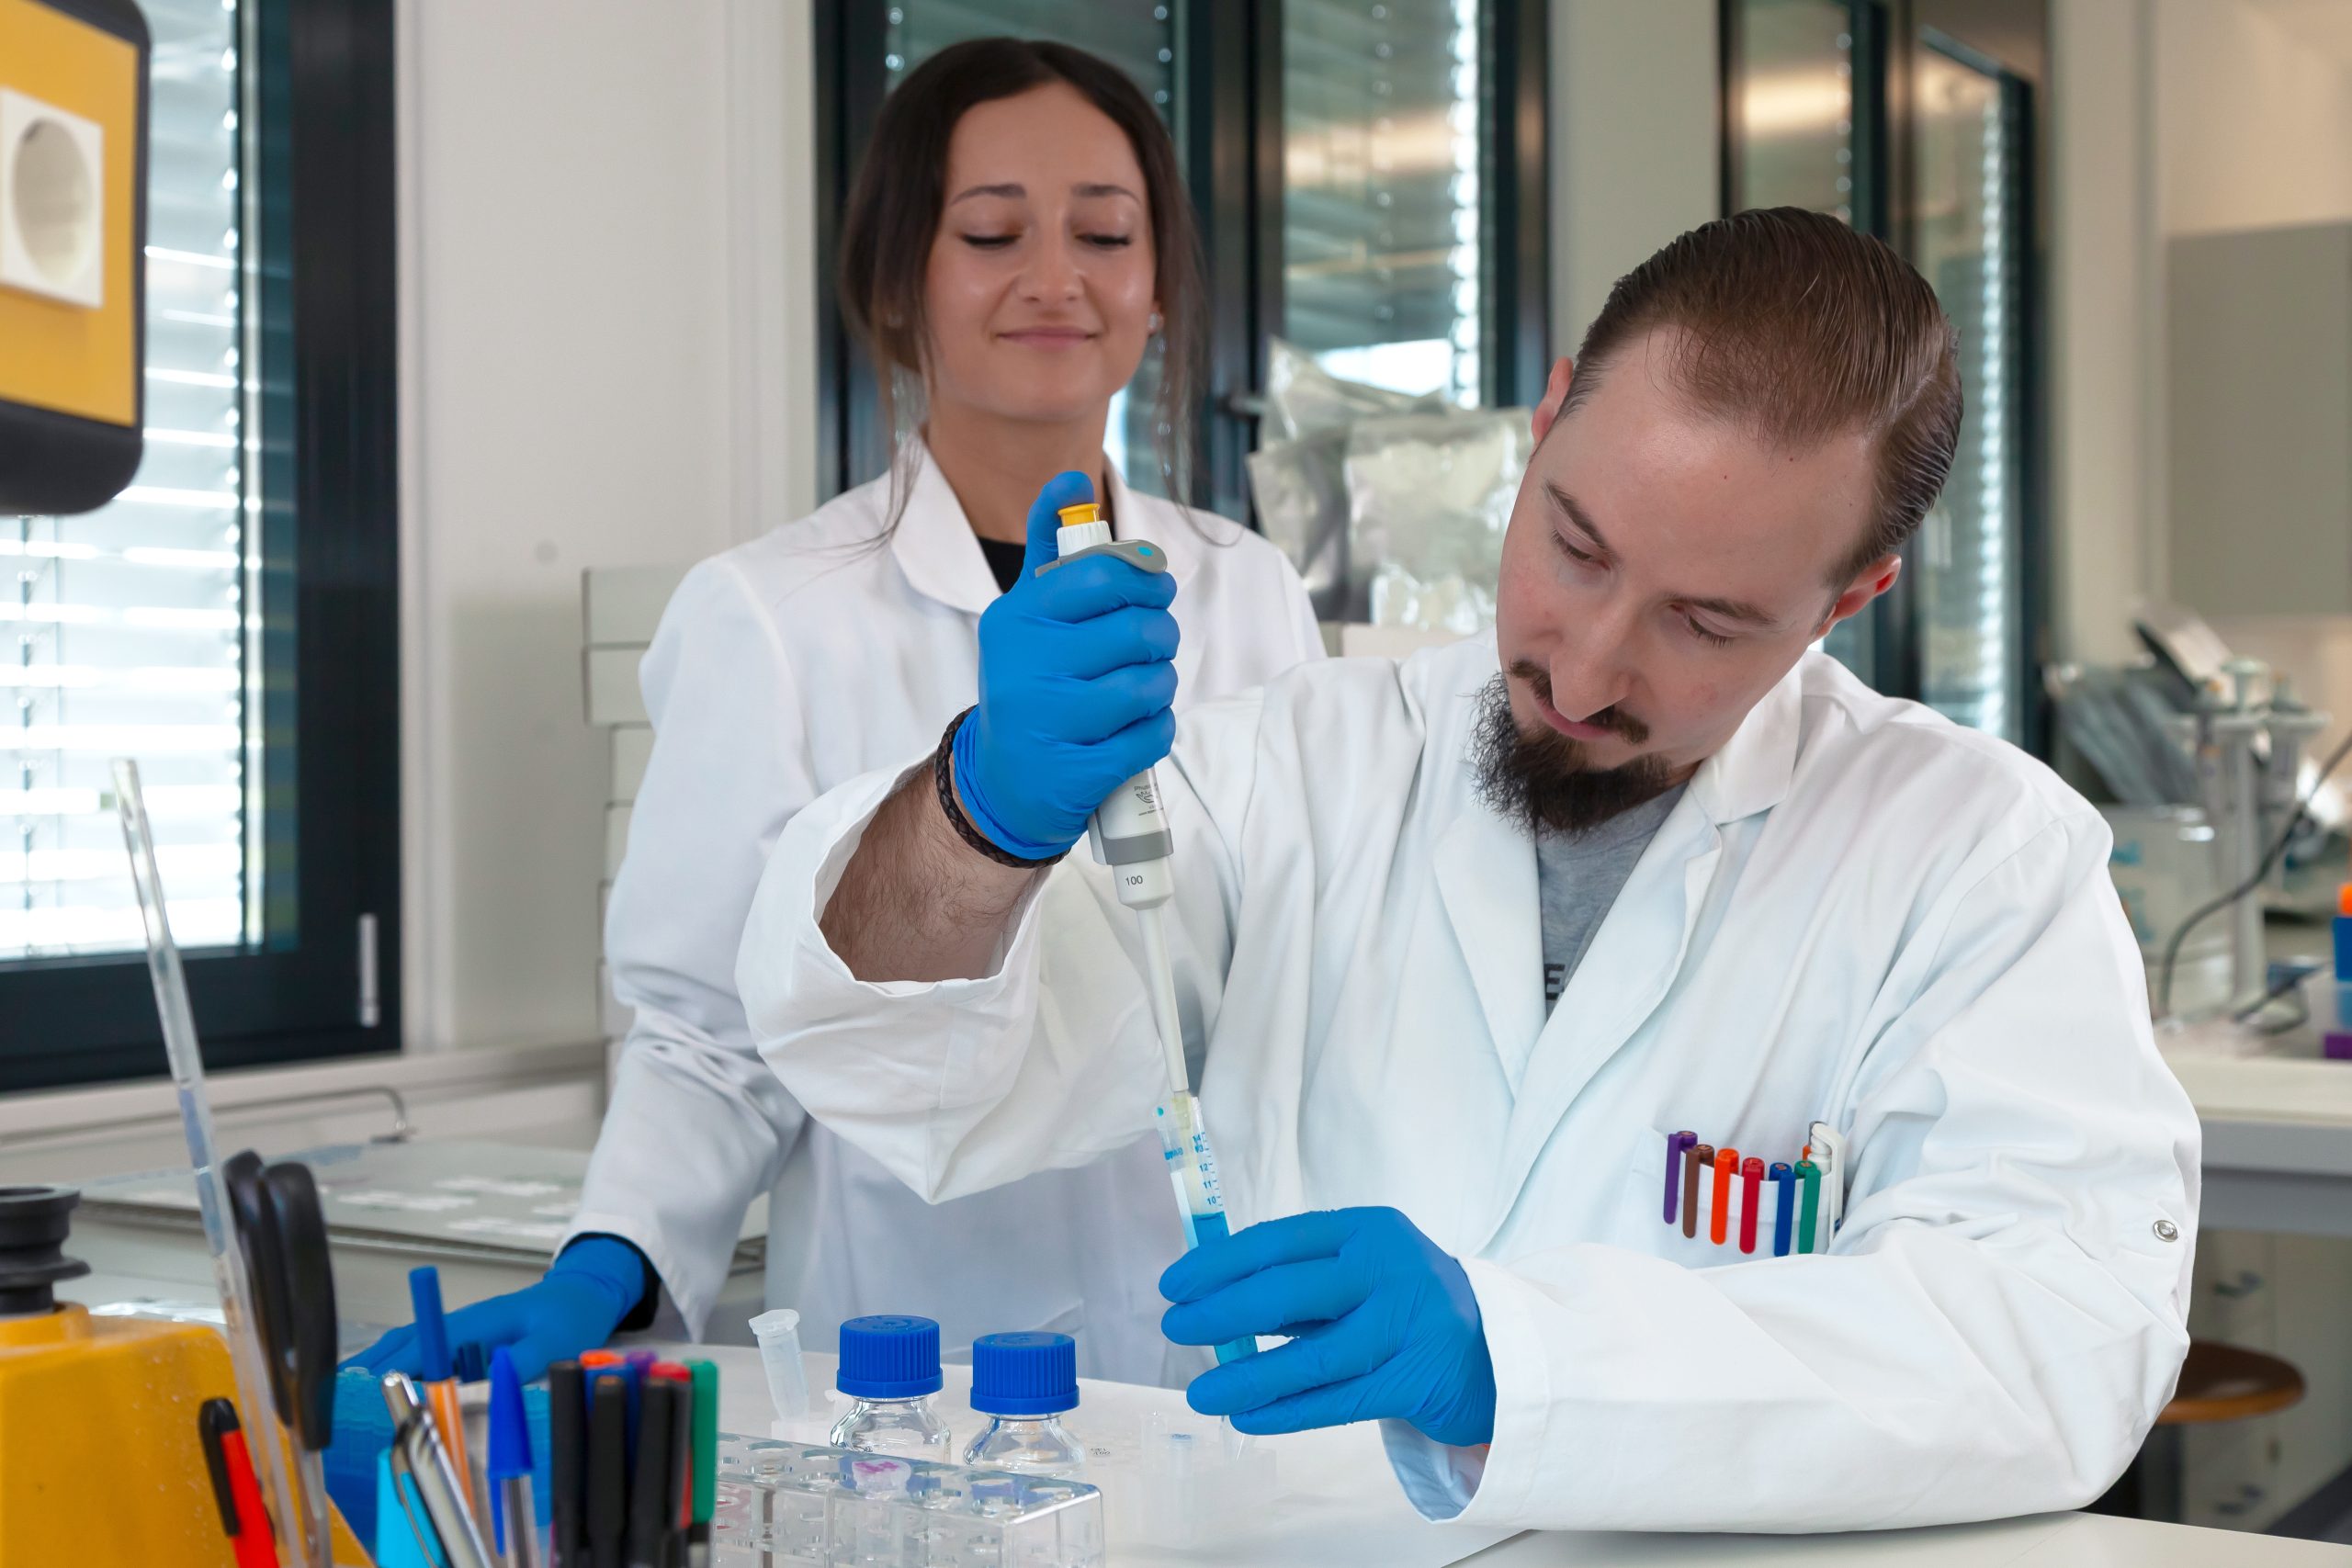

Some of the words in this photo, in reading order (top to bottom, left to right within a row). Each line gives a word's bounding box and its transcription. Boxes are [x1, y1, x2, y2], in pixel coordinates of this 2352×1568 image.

[1125, 875, 1143, 886] 100
[1199, 1163, 1208, 1172] 12
[1203, 1180, 1212, 1189] 11
[1207, 1196, 1216, 1205] 10
